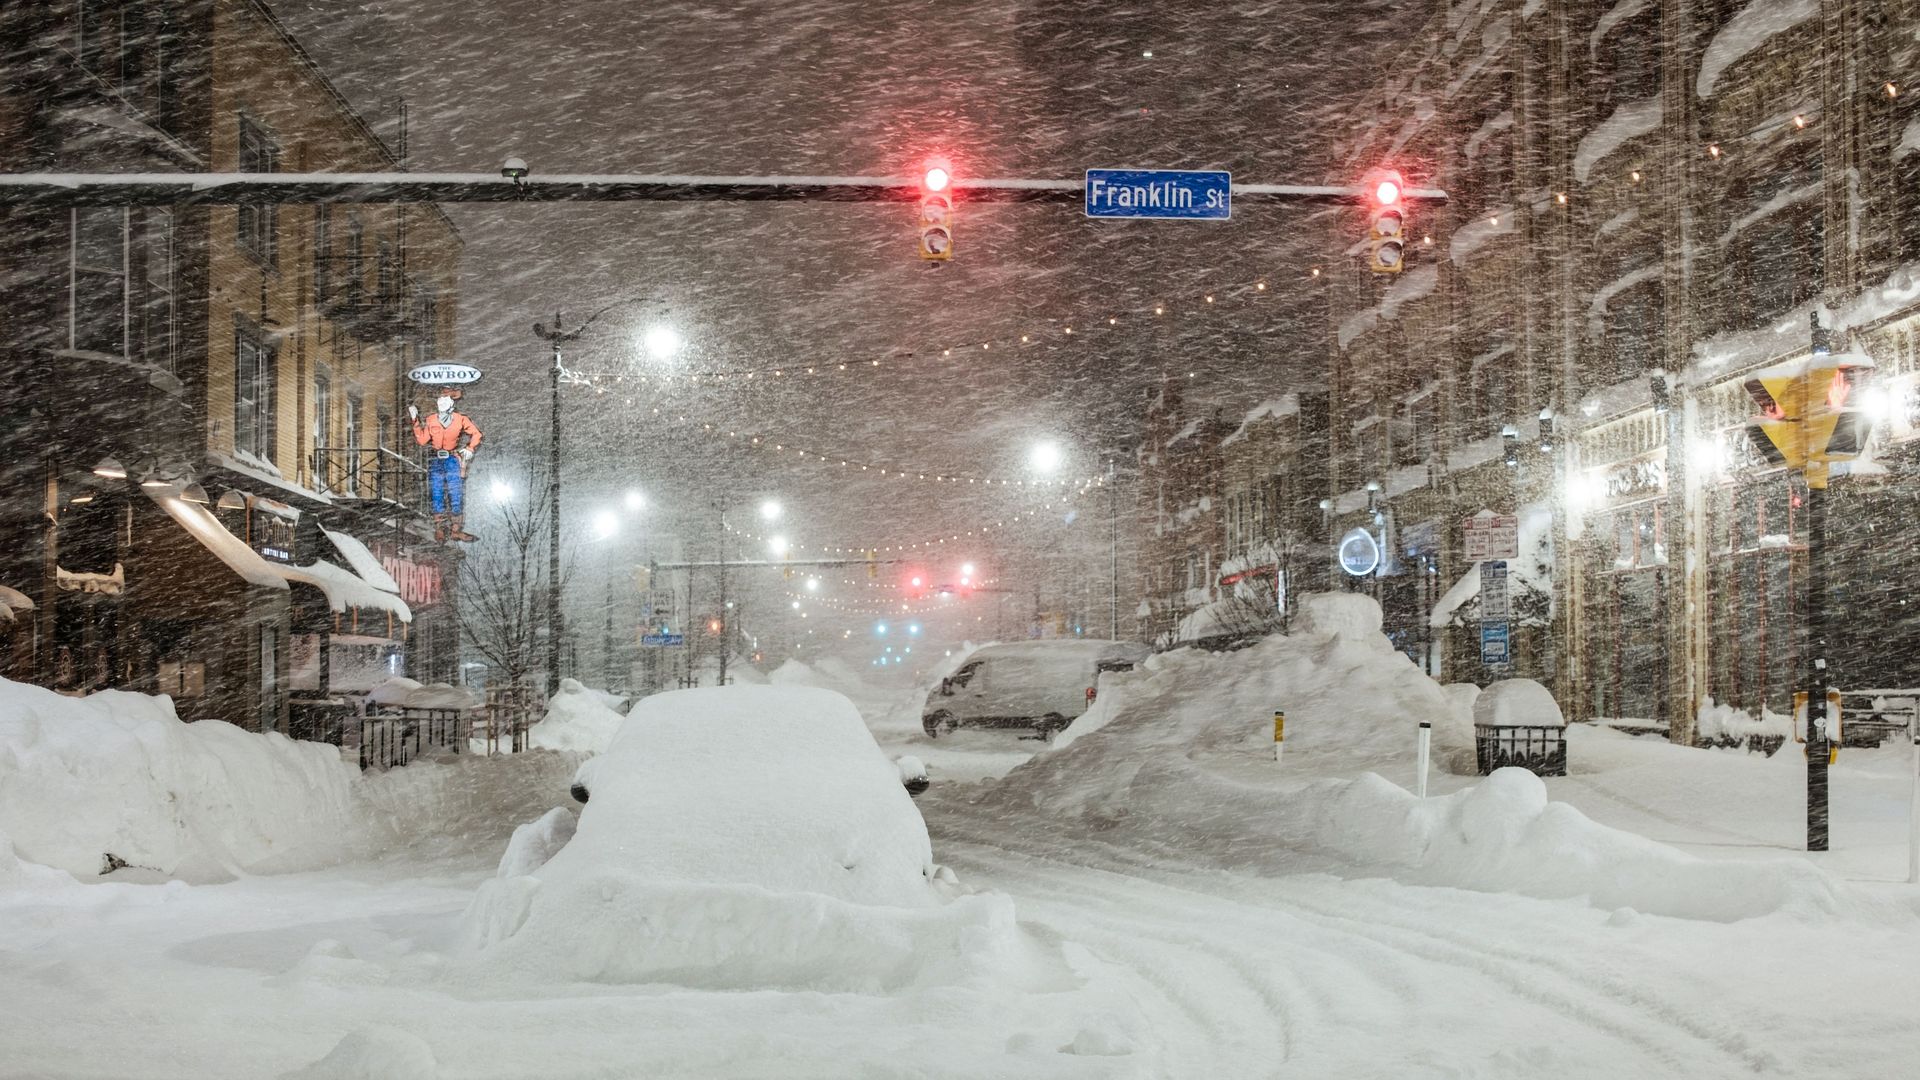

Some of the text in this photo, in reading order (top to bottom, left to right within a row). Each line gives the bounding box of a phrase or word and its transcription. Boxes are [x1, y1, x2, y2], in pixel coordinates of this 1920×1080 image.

[1091, 180, 1224, 208] Franklin St
[411, 370, 477, 379] COWBOY
